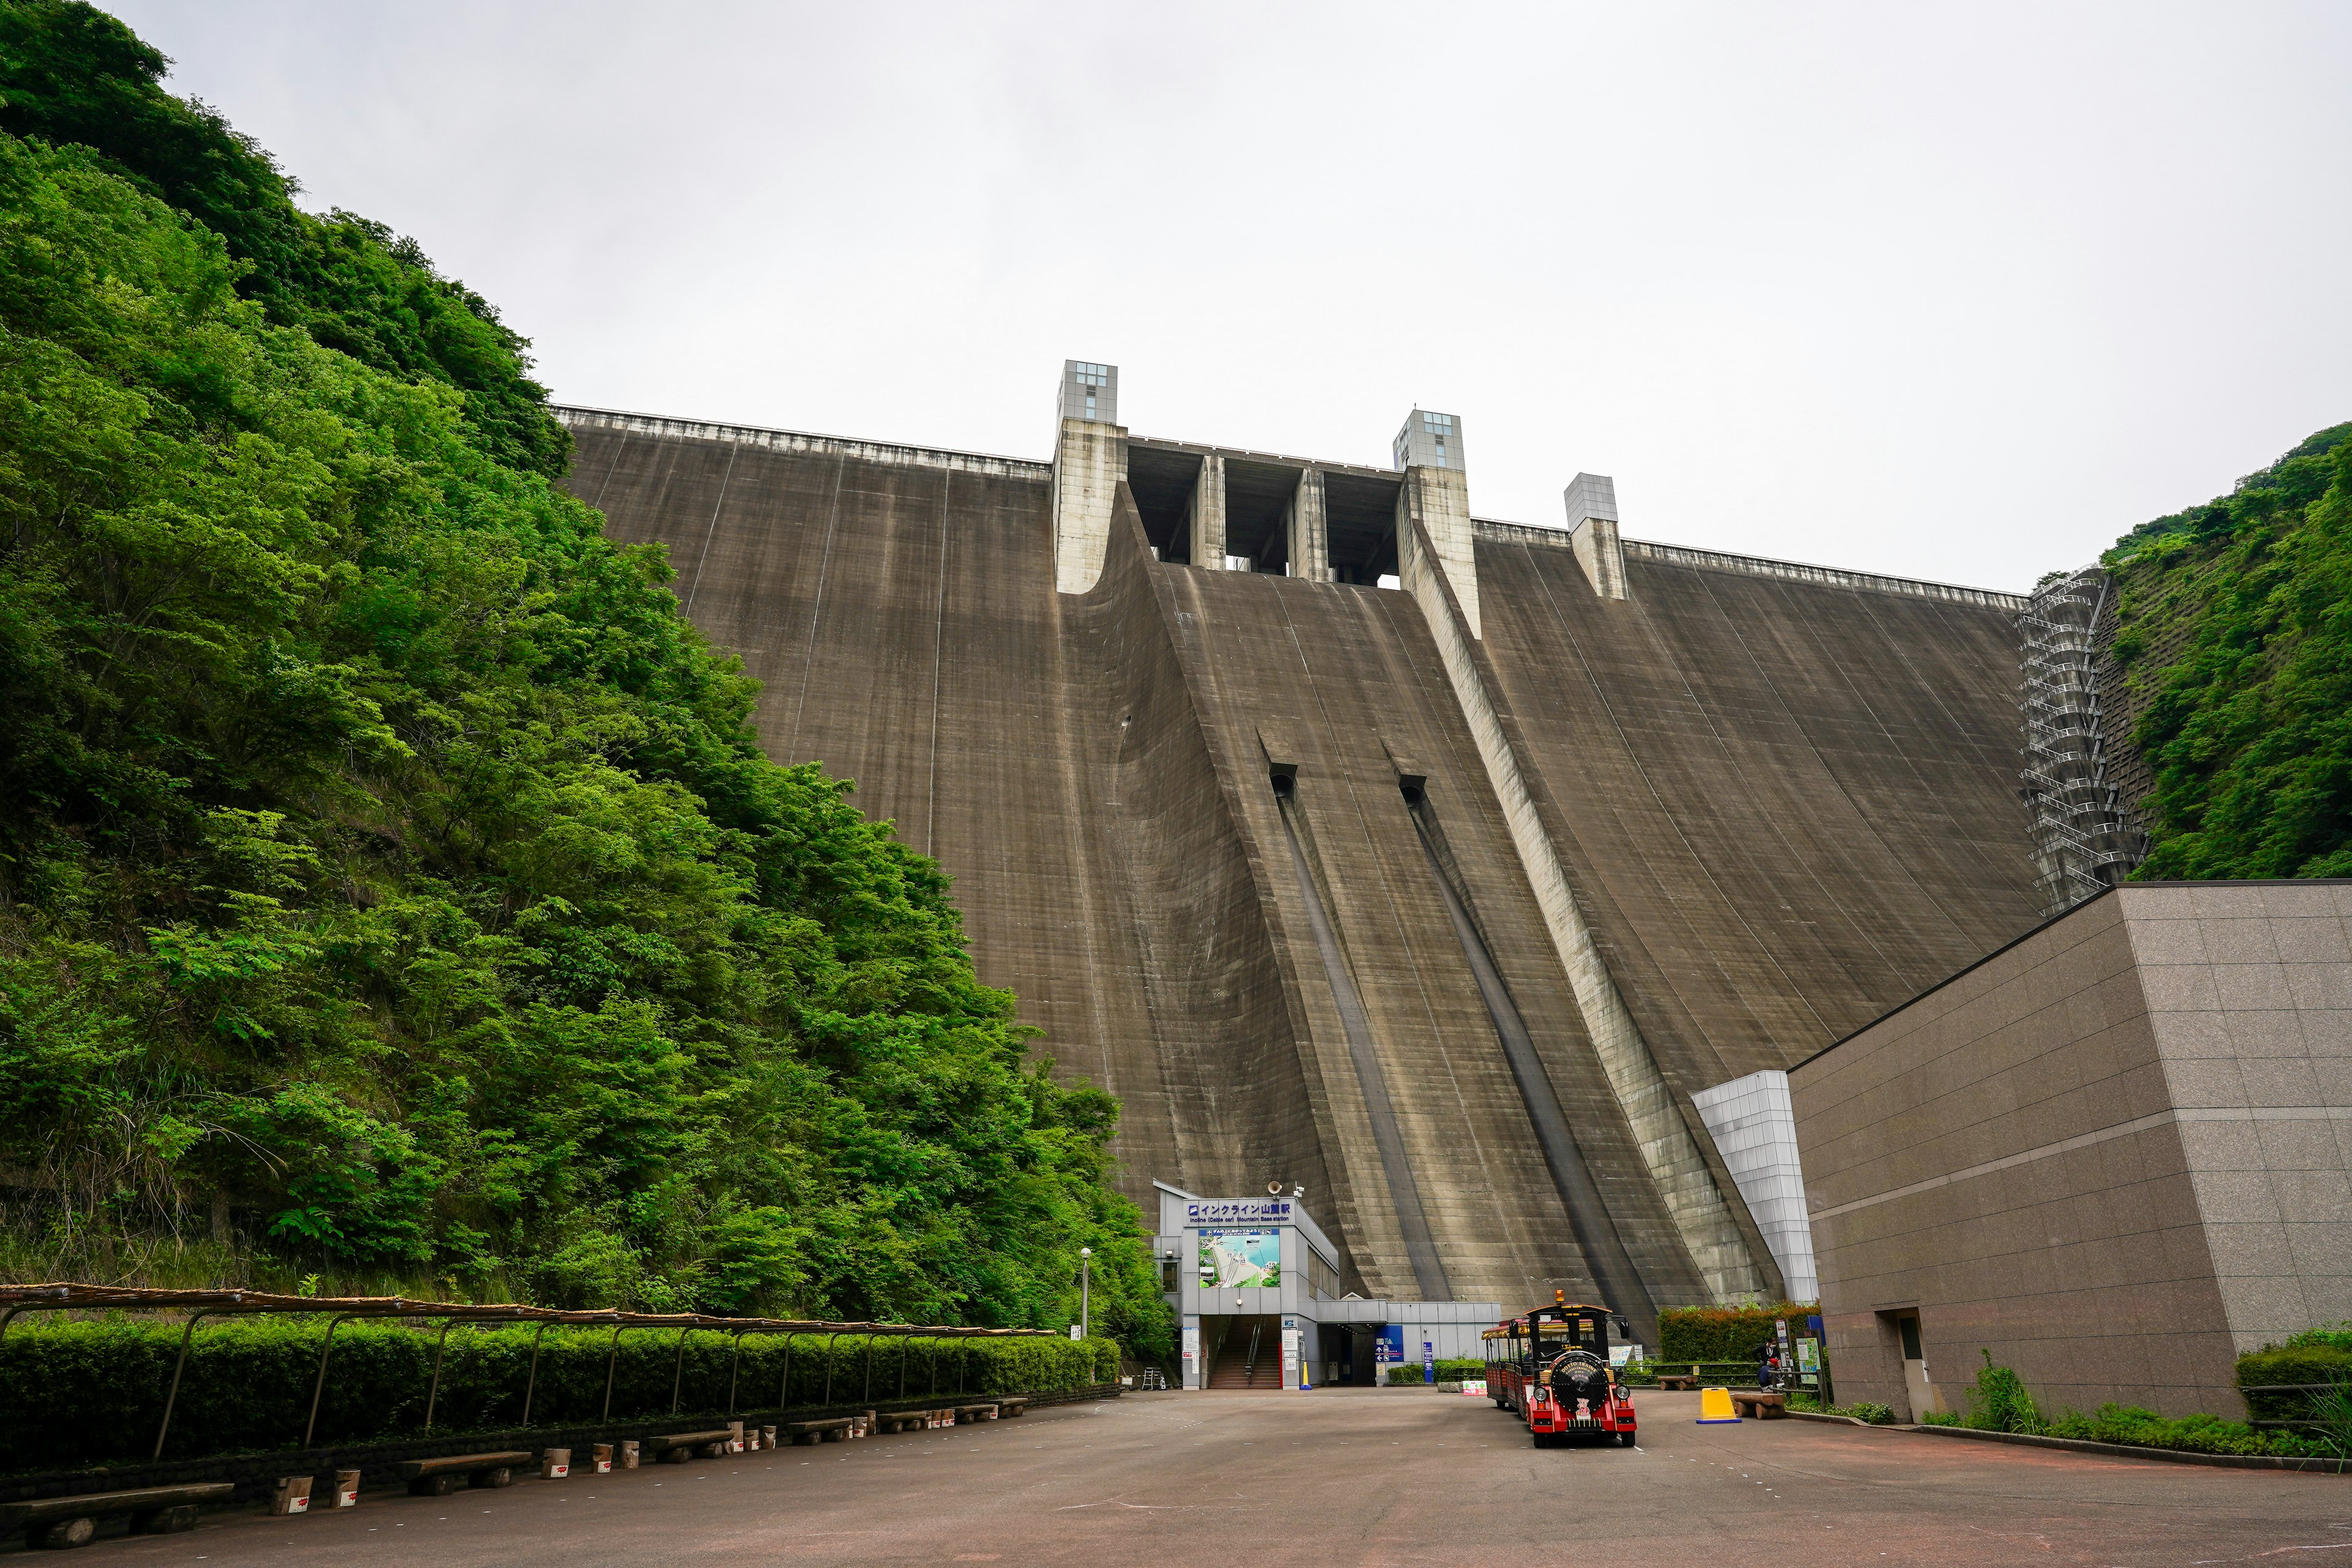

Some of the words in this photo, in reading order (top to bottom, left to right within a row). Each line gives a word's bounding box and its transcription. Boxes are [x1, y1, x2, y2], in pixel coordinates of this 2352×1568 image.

[1202, 1204, 1290, 1215] インクライン山麓駅
[1561, 1362, 1577, 1373] DOTTO
[1579, 1362, 1597, 1373] TRAINS
